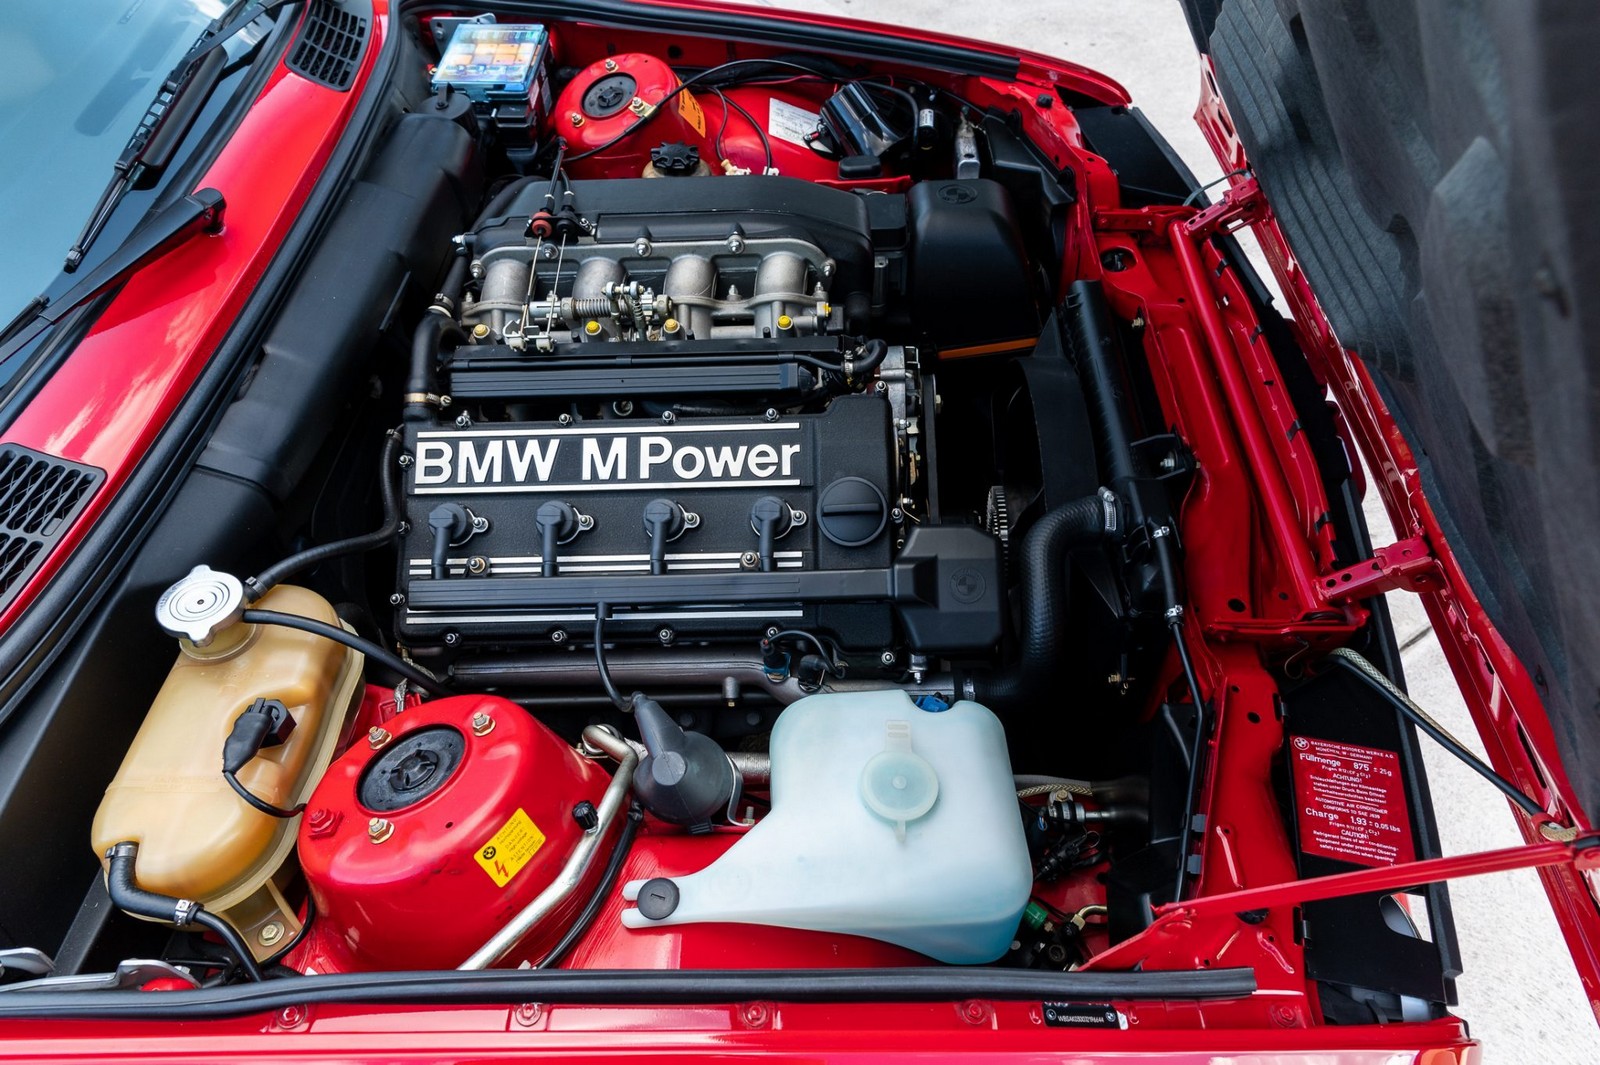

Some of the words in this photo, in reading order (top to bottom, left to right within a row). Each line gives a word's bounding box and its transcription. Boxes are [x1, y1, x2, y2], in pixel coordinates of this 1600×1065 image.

[415, 439, 560, 484] BMW
[582, 437, 628, 480] M
[639, 436, 801, 479] Power
[1300, 753, 1341, 767] Füllmenge
[1353, 762, 1369, 771] 875
[1333, 774, 1362, 782] ACHTUNG!
[1359, 784, 1386, 793] Klimaanlage
[1315, 797, 1344, 806] AUTOMOTIVE
[1356, 804, 1388, 814] CONDITIONER
[1305, 807, 1339, 821] Charge
[1350, 816, 1367, 825] 1.93
[1313, 830, 1339, 839] Refrigerant
[1341, 829, 1369, 838] CAUTION!
[1335, 847, 1360, 855] regulations
